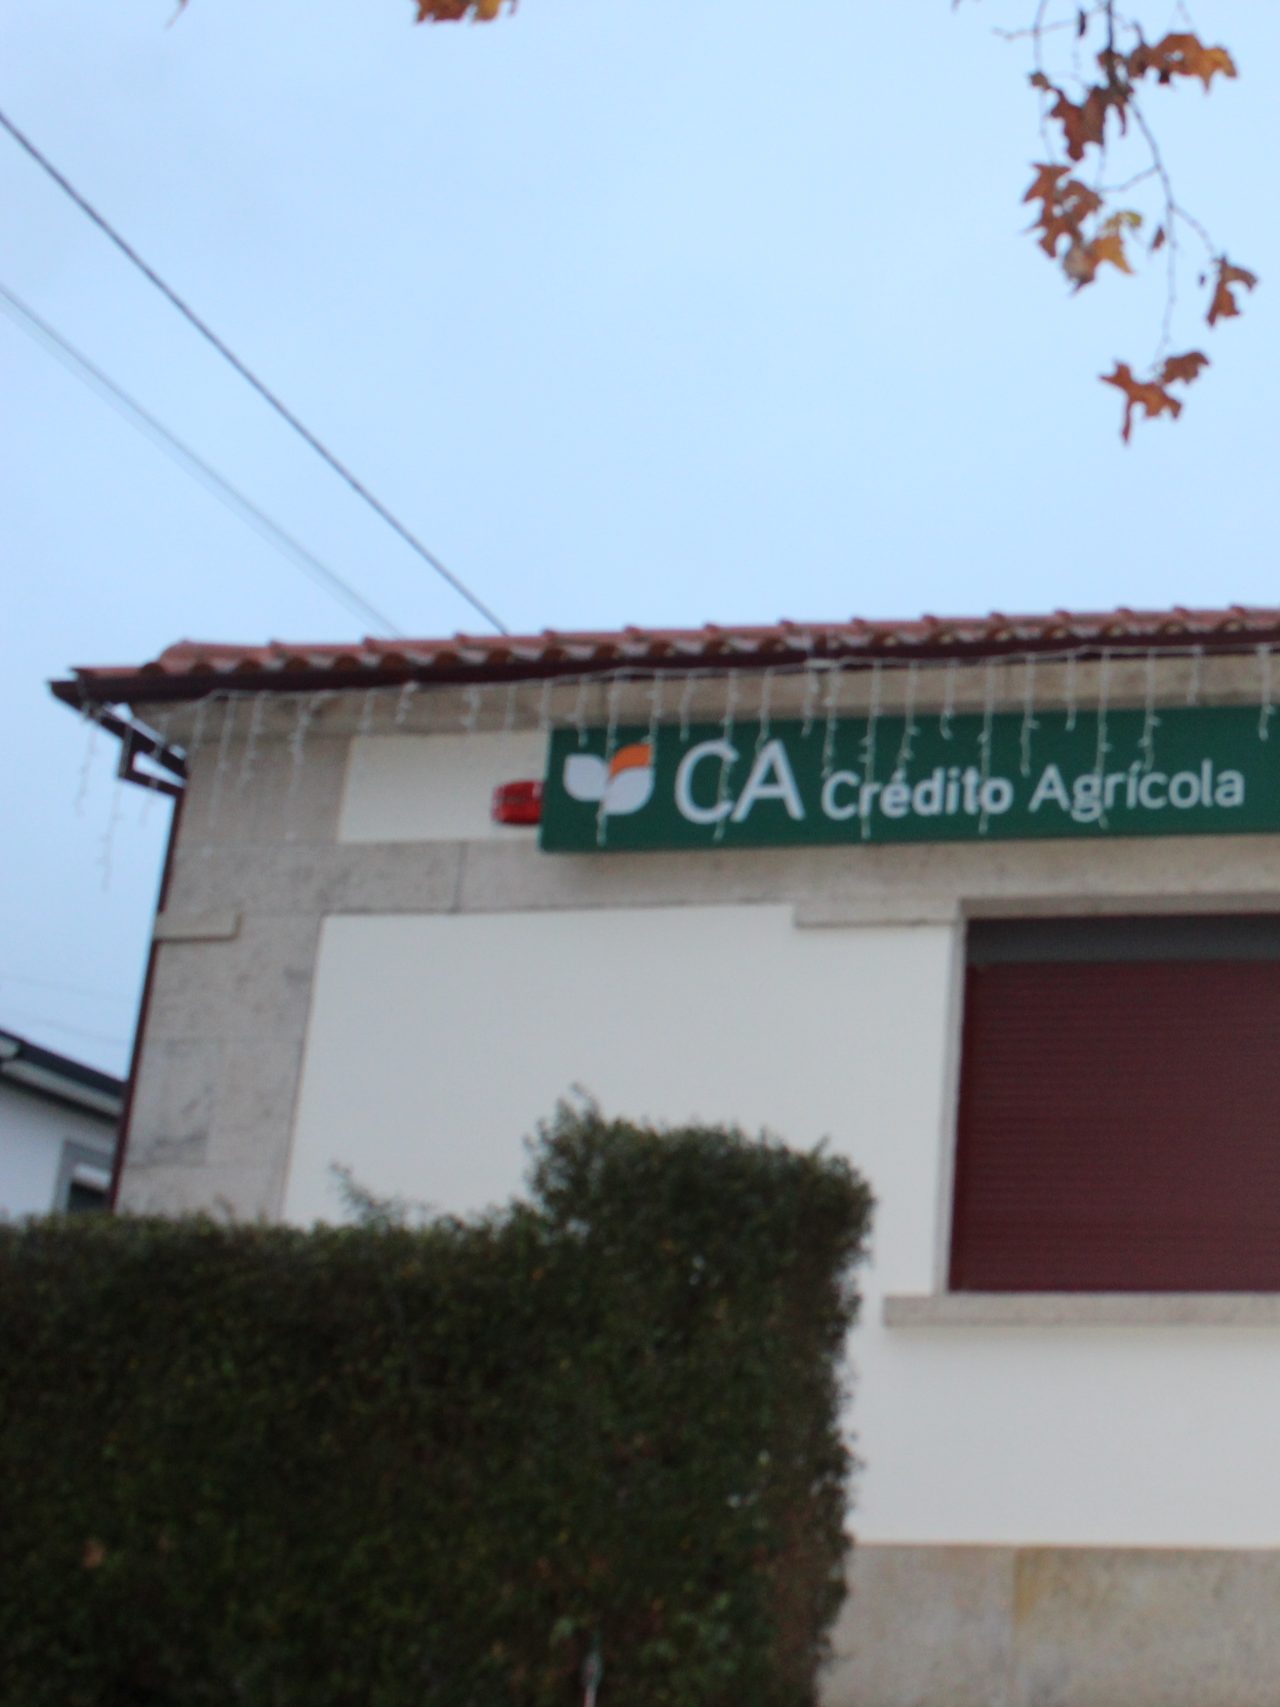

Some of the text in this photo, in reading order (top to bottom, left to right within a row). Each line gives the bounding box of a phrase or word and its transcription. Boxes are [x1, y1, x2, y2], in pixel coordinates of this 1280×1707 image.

[674, 738, 1245, 824] CA Crédito Agrícola
